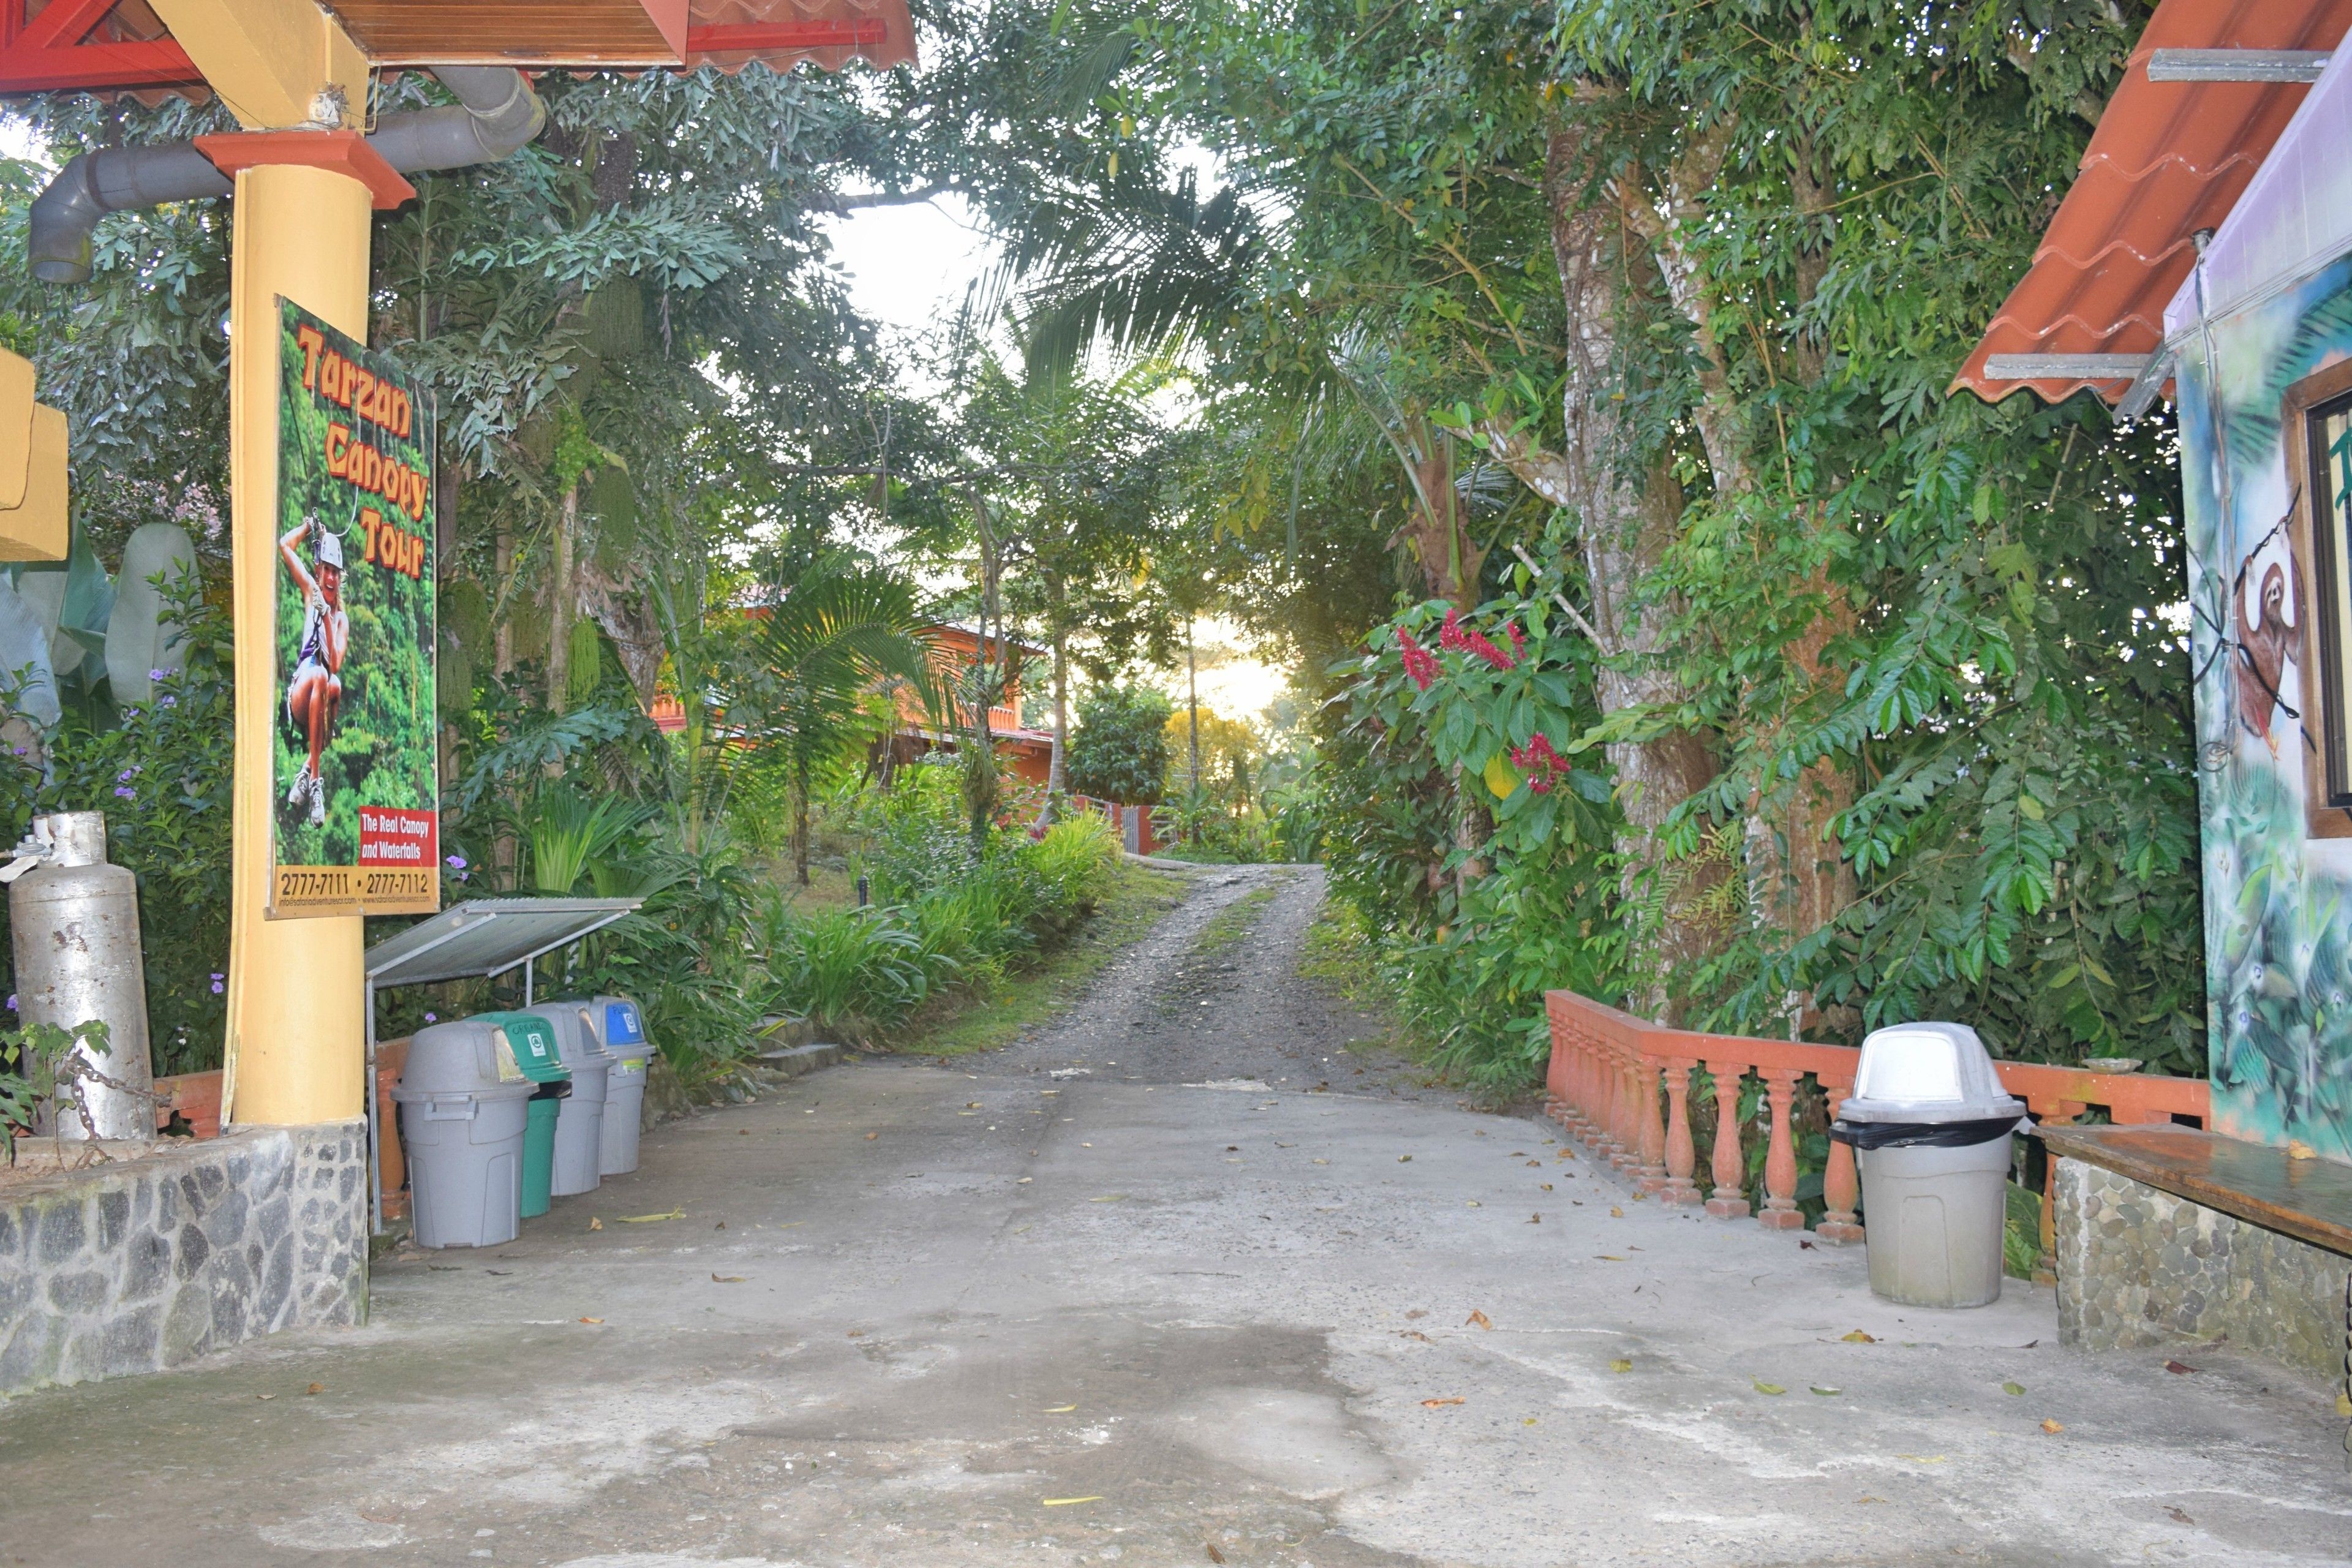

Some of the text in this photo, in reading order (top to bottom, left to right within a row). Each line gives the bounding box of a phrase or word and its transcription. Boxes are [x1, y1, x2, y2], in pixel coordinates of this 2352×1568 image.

[298, 324, 411, 437] Tarzan
[325, 421, 429, 521] Canopy
[361, 507, 424, 579] Tour
[362, 813, 429, 838] The Real Canopy
[362, 841, 421, 859] and Waterfalls
[281, 873, 428, 895] 2777-7111 2777-7112
